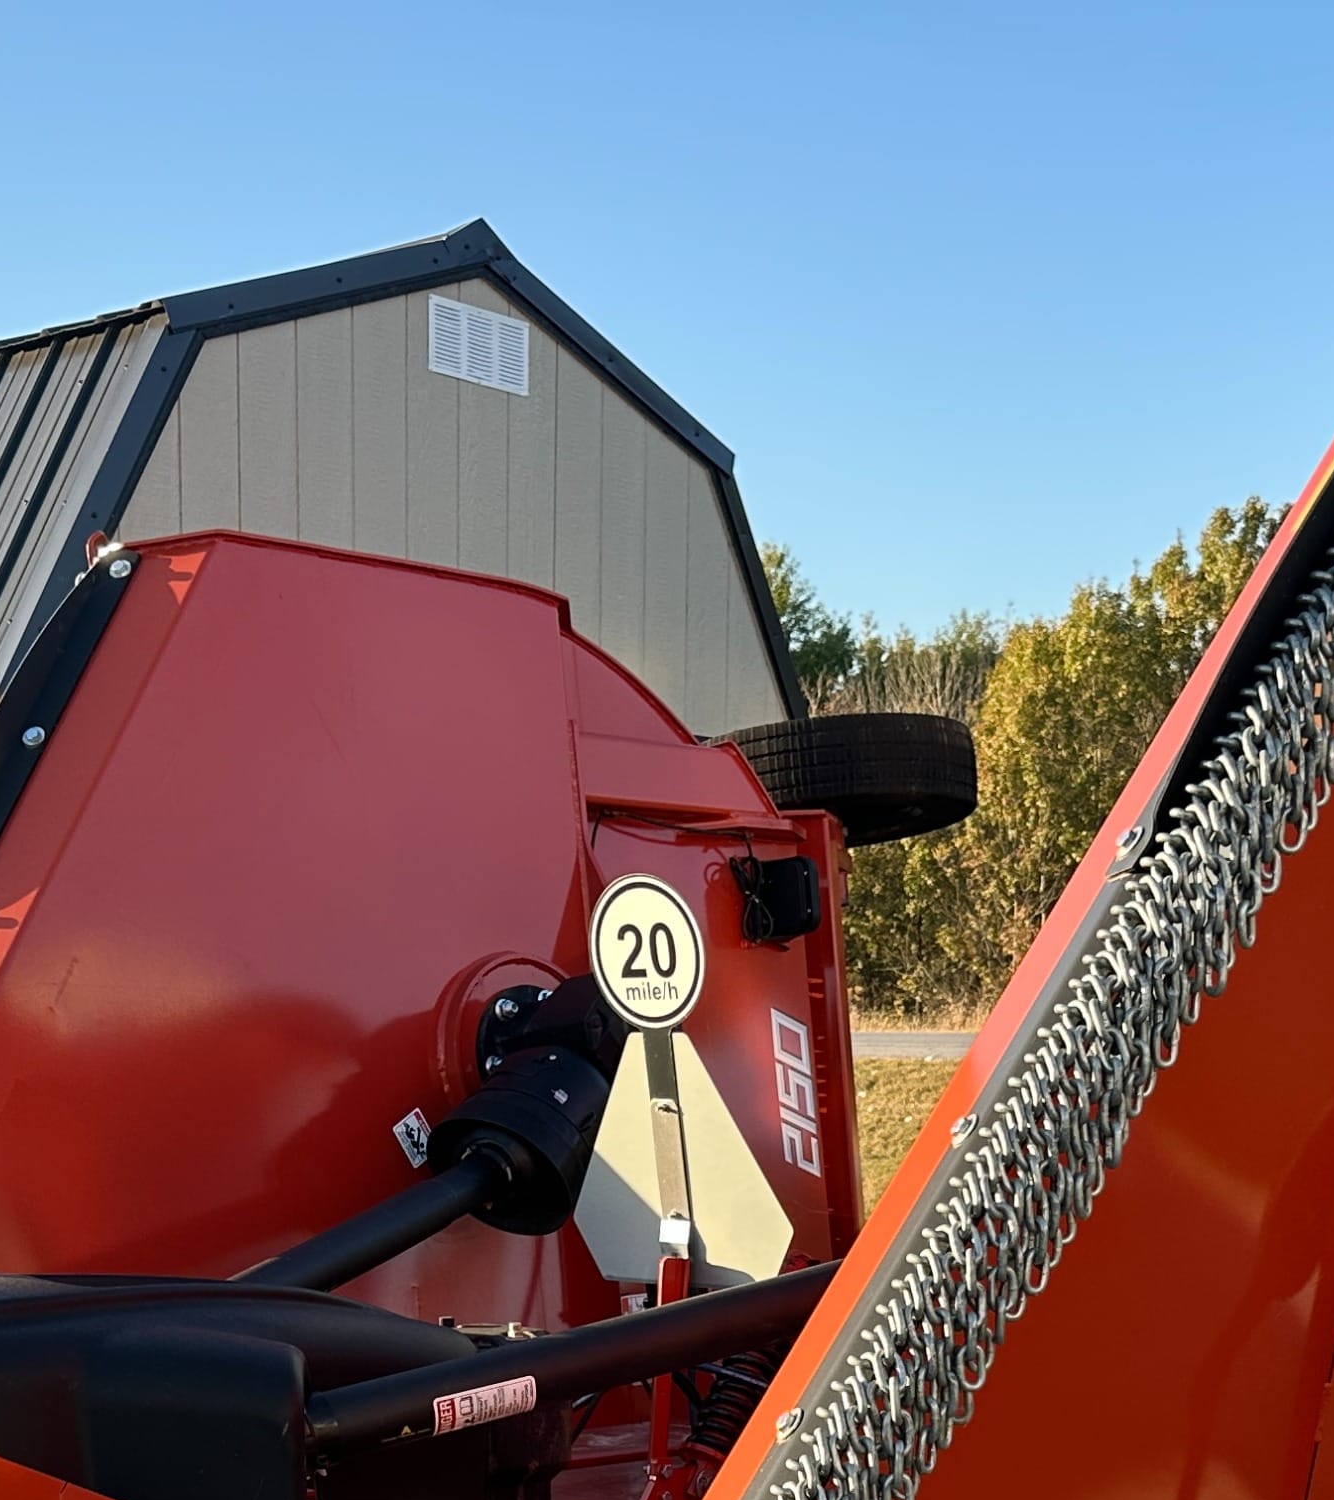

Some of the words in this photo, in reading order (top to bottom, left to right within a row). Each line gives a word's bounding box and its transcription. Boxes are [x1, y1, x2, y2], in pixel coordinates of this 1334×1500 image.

[617, 922, 677, 979] 20
[626, 981, 679, 1001] mile/h
[770, 1007, 822, 1178] 2150
